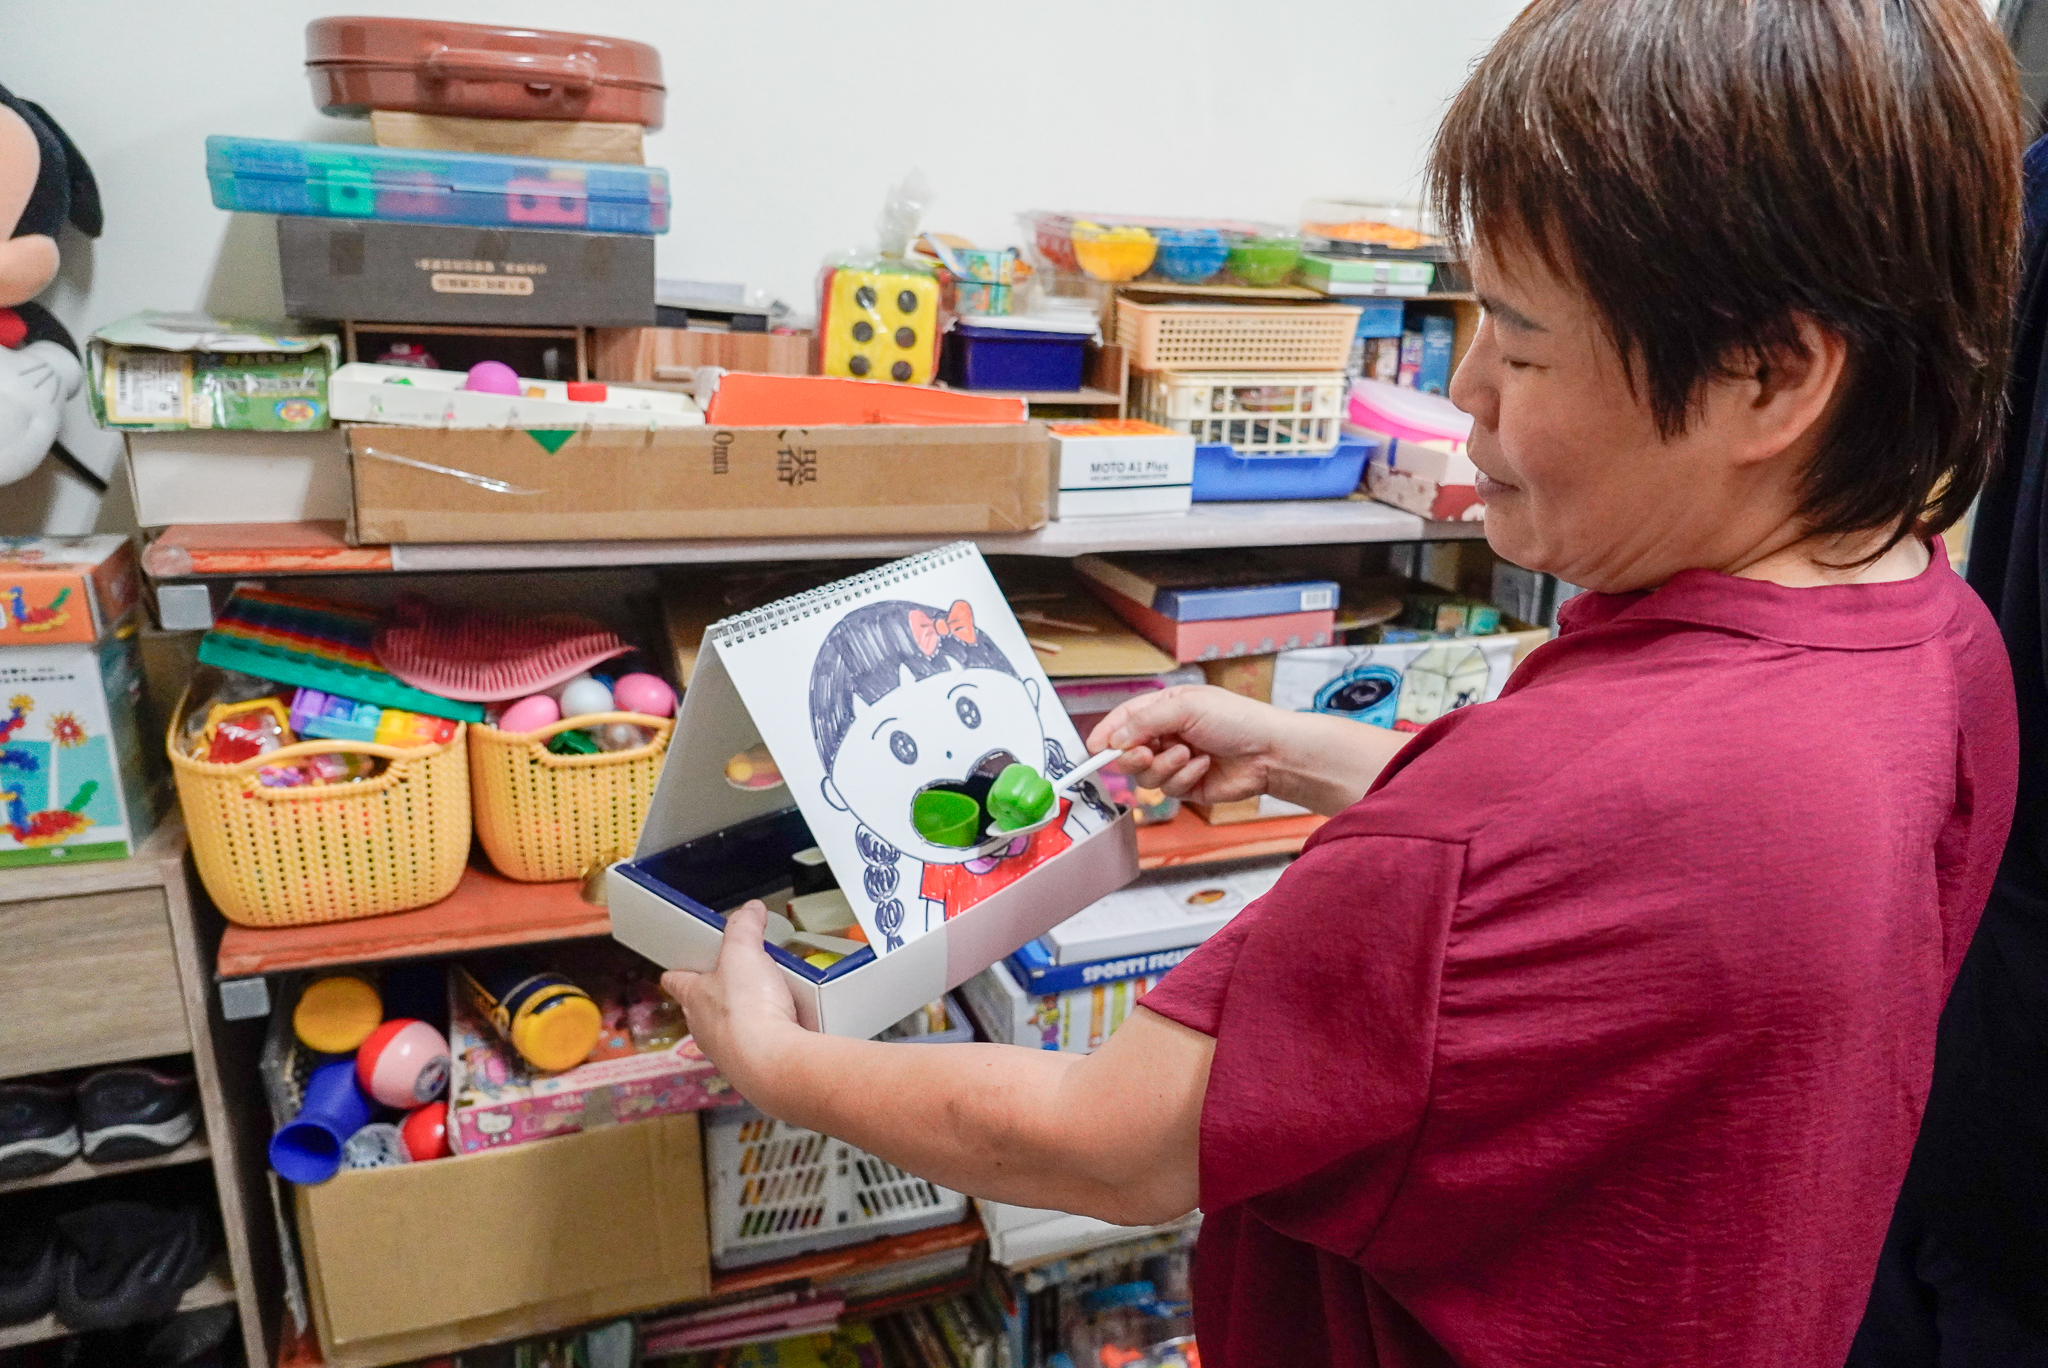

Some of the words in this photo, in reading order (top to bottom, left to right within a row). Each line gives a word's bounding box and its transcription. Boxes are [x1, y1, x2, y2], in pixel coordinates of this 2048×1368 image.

[777, 429, 817, 486] 器
[1090, 462, 1125, 473] MOTO
[1146, 461, 1169, 472] Plus
[1082, 957, 1146, 983] SPORTS
